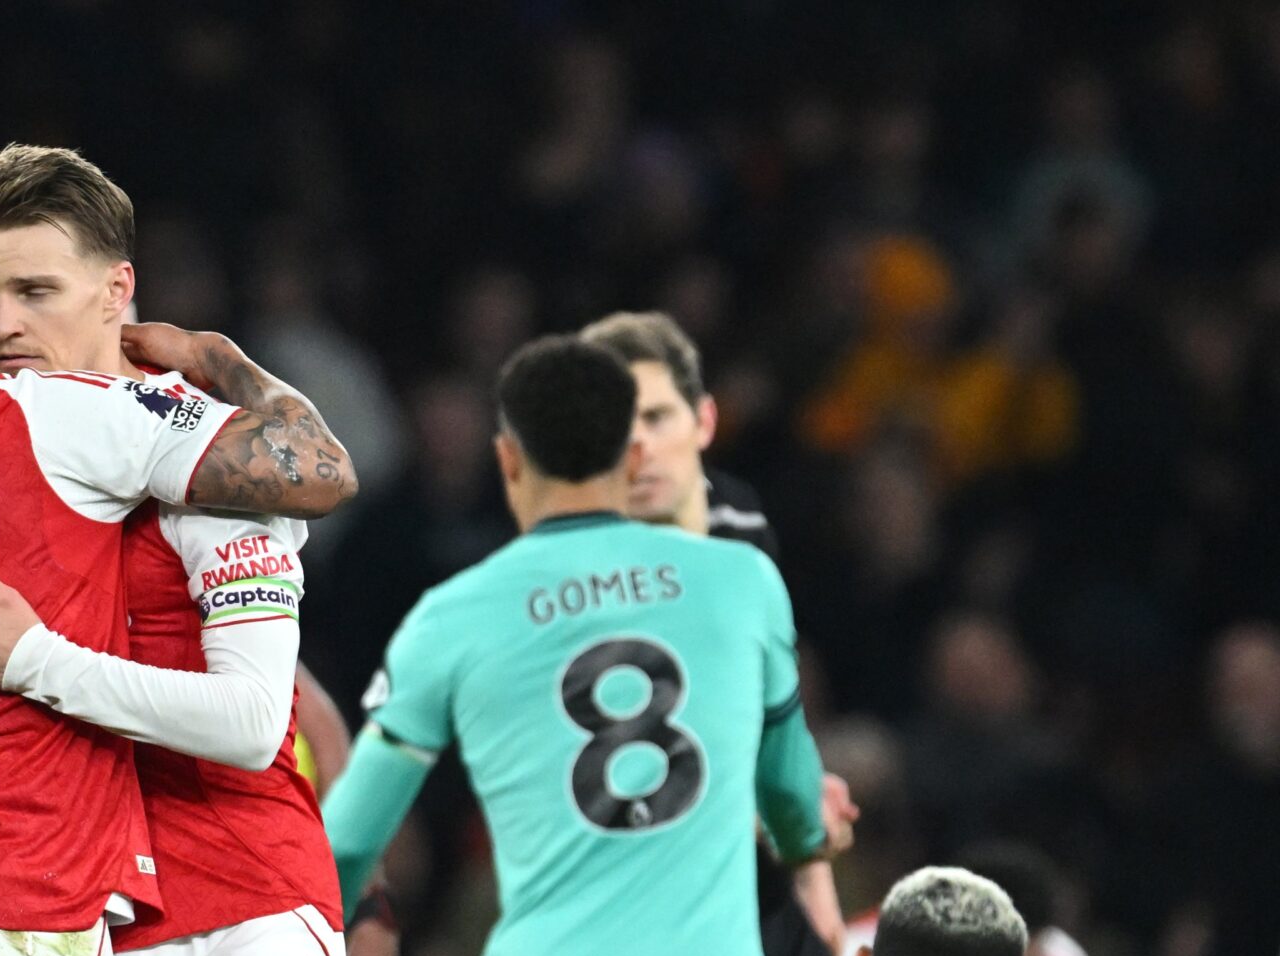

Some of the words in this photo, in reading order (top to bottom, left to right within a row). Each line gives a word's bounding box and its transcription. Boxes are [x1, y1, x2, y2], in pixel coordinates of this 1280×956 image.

[215, 535, 269, 563] VISIT
[201, 554, 294, 591] RWANDA
[211, 587, 296, 609] Captain
[528, 564, 683, 626] GOMES
[559, 635, 706, 831] 8
